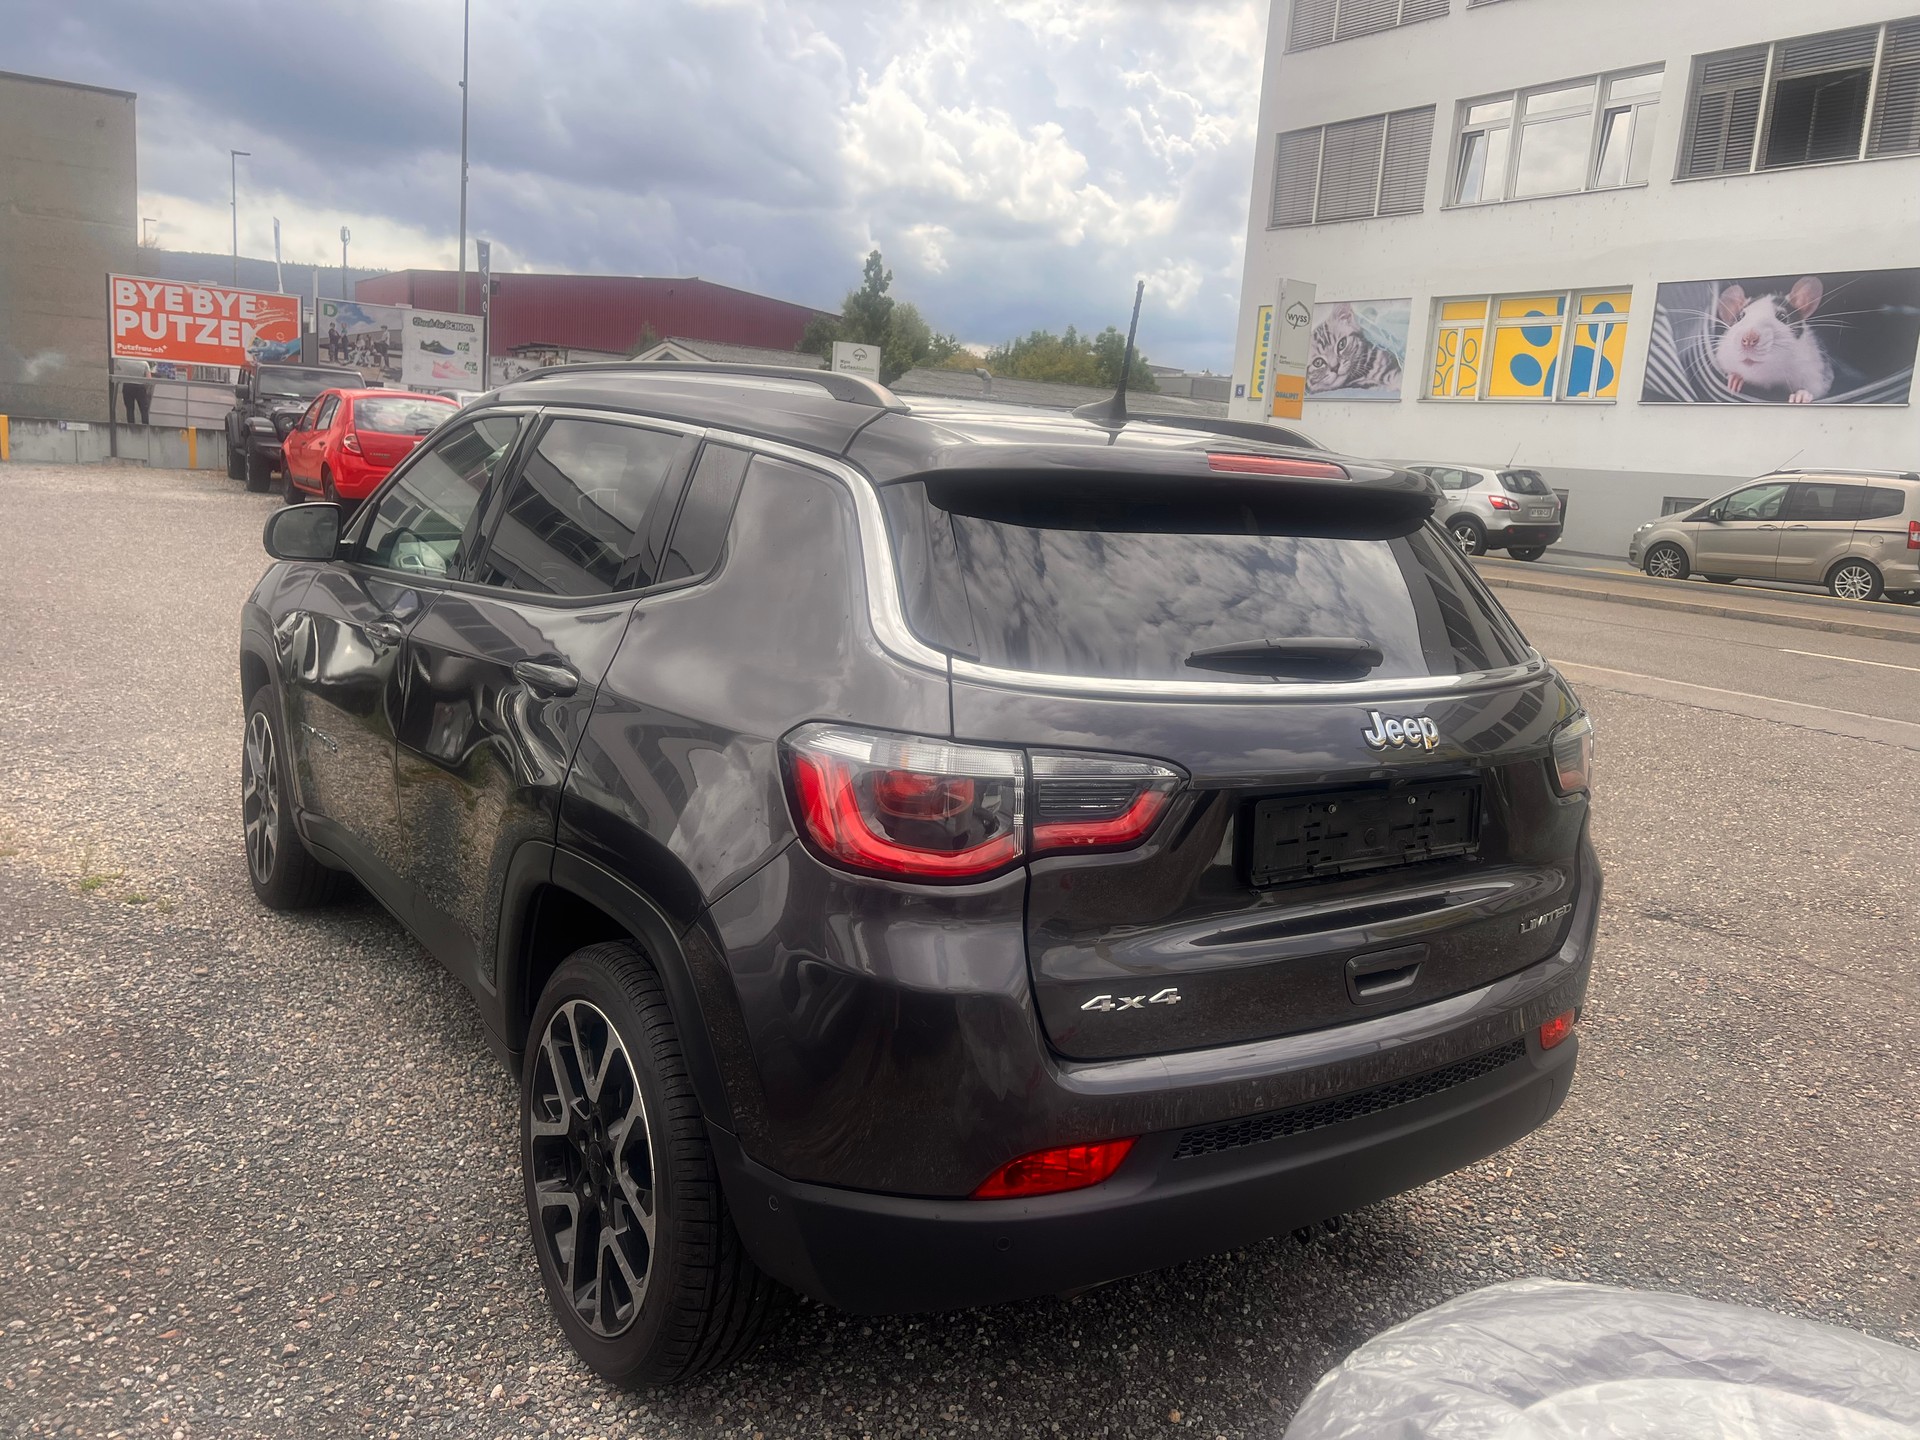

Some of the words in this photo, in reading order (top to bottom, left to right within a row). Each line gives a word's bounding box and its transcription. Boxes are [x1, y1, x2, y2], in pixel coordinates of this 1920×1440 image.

[115, 280, 184, 312] BYE
[192, 288, 257, 320] BYE
[444, 320, 475, 332] SCHOOL
[1287, 312, 1308, 330] wyss
[1362, 708, 1440, 754] Jeep
[1519, 902, 1573, 935] LIMITED
[1080, 986, 1182, 1012] 4x4
